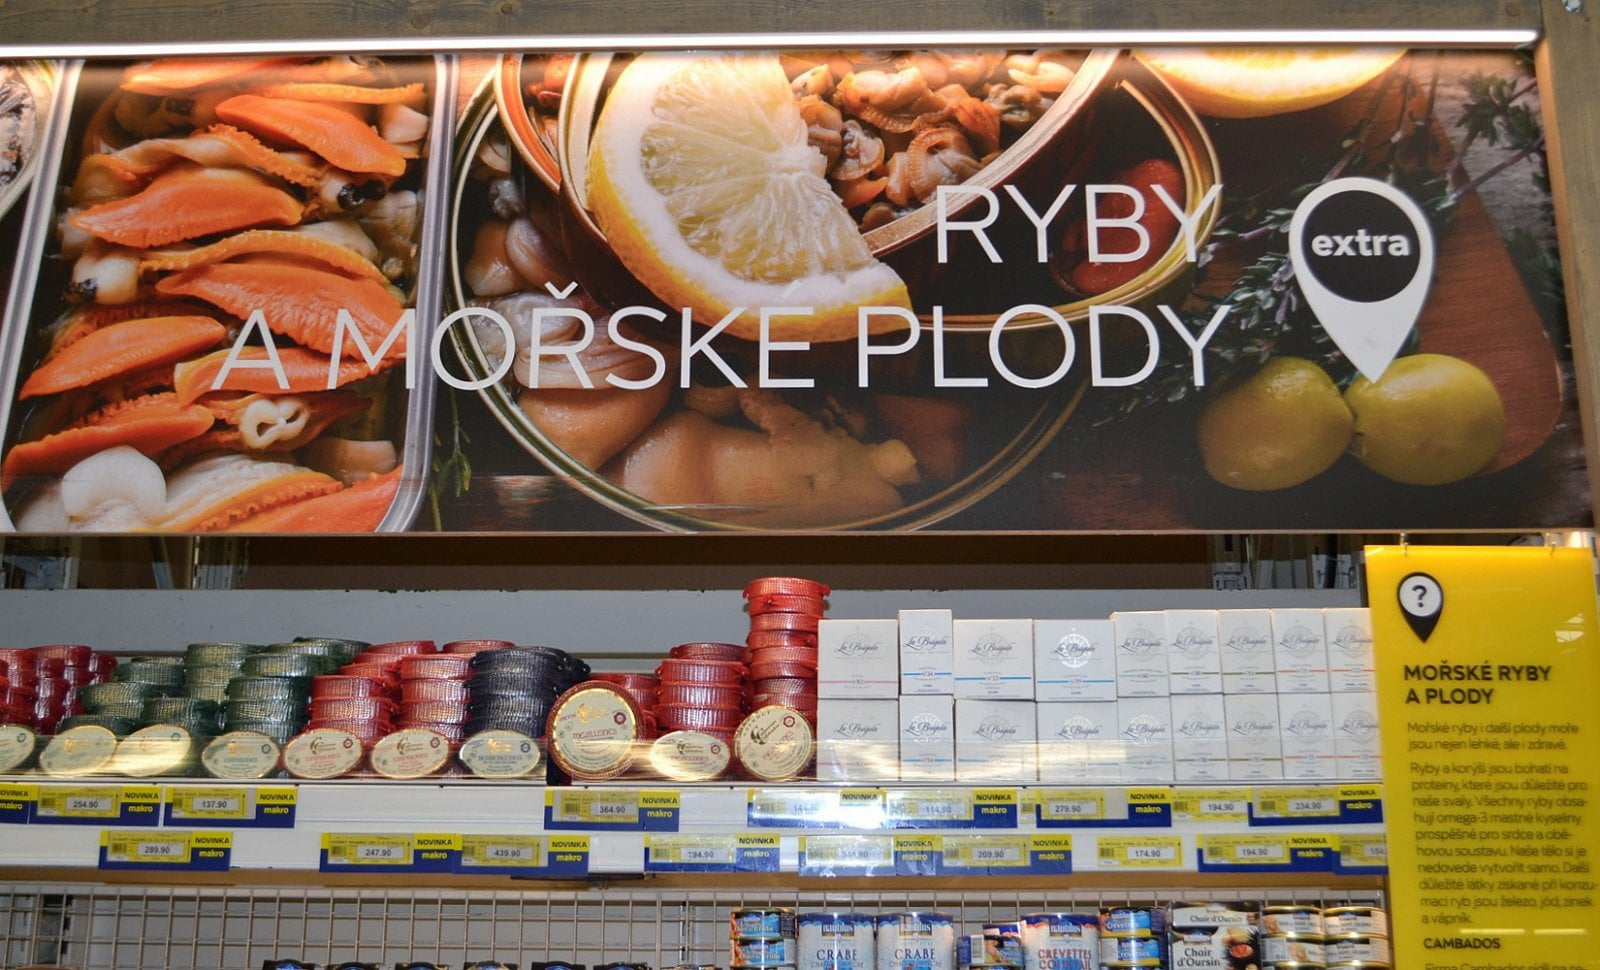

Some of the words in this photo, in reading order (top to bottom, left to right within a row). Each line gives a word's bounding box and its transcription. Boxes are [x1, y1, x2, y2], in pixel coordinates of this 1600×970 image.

[936, 184, 1224, 264] RYBY
[1311, 229, 1411, 258] extra
[211, 309, 292, 391] A
[325, 280, 816, 391] MOŘSKÉ
[858, 304, 1232, 389] PLODY
[1404, 660, 1493, 681] MOŘSKÉ
[1498, 665, 1552, 681] RYBY
[1405, 688, 1420, 704] A
[1426, 688, 1494, 704] PLODY
[1407, 722, 1449, 733] Mořské
[1452, 722, 1478, 736] ryby
[1514, 722, 1546, 736] plody
[1550, 723, 1579, 733] moře
[1409, 739, 1432, 751] jsou
[1435, 739, 1467, 751] nejen
[1503, 738, 1520, 749] ale
[1410, 762, 1439, 776] Ryby
[1443, 765, 1450, 773] a
[1488, 763, 1512, 776] jsou
[1554, 765, 1568, 773] na
[1462, 779, 1492, 790] které
[1495, 780, 1518, 793] jsou
[1521, 778, 1565, 790] důležité
[1568, 781, 1588, 792] pro
[1413, 796, 1439, 806] naše
[1475, 795, 1524, 808] Všechny
[1527, 796, 1553, 808] ryby
[128, 805, 153, 813] makro
[263, 806, 289, 814] makro
[647, 810, 673, 818] makro
[981, 806, 1007, 814] makro
[1135, 805, 1162, 813] makro
[1414, 812, 1434, 825] hují
[1437, 812, 1487, 825] omega-3
[1491, 812, 1533, 823] mastné
[1536, 811, 1582, 825] kyseliny
[1415, 828, 1477, 842] prospěšné
[1479, 830, 1500, 841] pro
[1502, 828, 1533, 840] srdce
[1536, 831, 1543, 840] a
[198, 850, 224, 858] makro
[421, 851, 447, 860] makro
[902, 852, 928, 860] makro
[1038, 852, 1064, 860] makro
[1417, 845, 1453, 856] hovou
[1511, 844, 1539, 856] Naše
[1541, 844, 1562, 856] tělo
[1564, 846, 1573, 856] si
[1575, 845, 1586, 859] je
[1418, 862, 1478, 873] nedovede
[1480, 862, 1524, 875] vytvořit
[1563, 862, 1590, 873] Další
[1419, 878, 1464, 890] důležité
[1467, 878, 1494, 892] látky
[1497, 878, 1539, 890] získané
[1542, 879, 1558, 892] při
[1450, 896, 1471, 909] ryb
[1473, 896, 1498, 909] jsou
[1563, 896, 1593, 907] zinek
[1421, 915, 1429, 924] a
[1423, 938, 1500, 949] CAMBADOS
[816, 949, 858, 960] CRABE
[895, 948, 936, 960] CRABE
[1038, 949, 1092, 960] CREVETTES
[1184, 947, 1212, 957] Chair
[1177, 957, 1221, 967] d'Oursin
